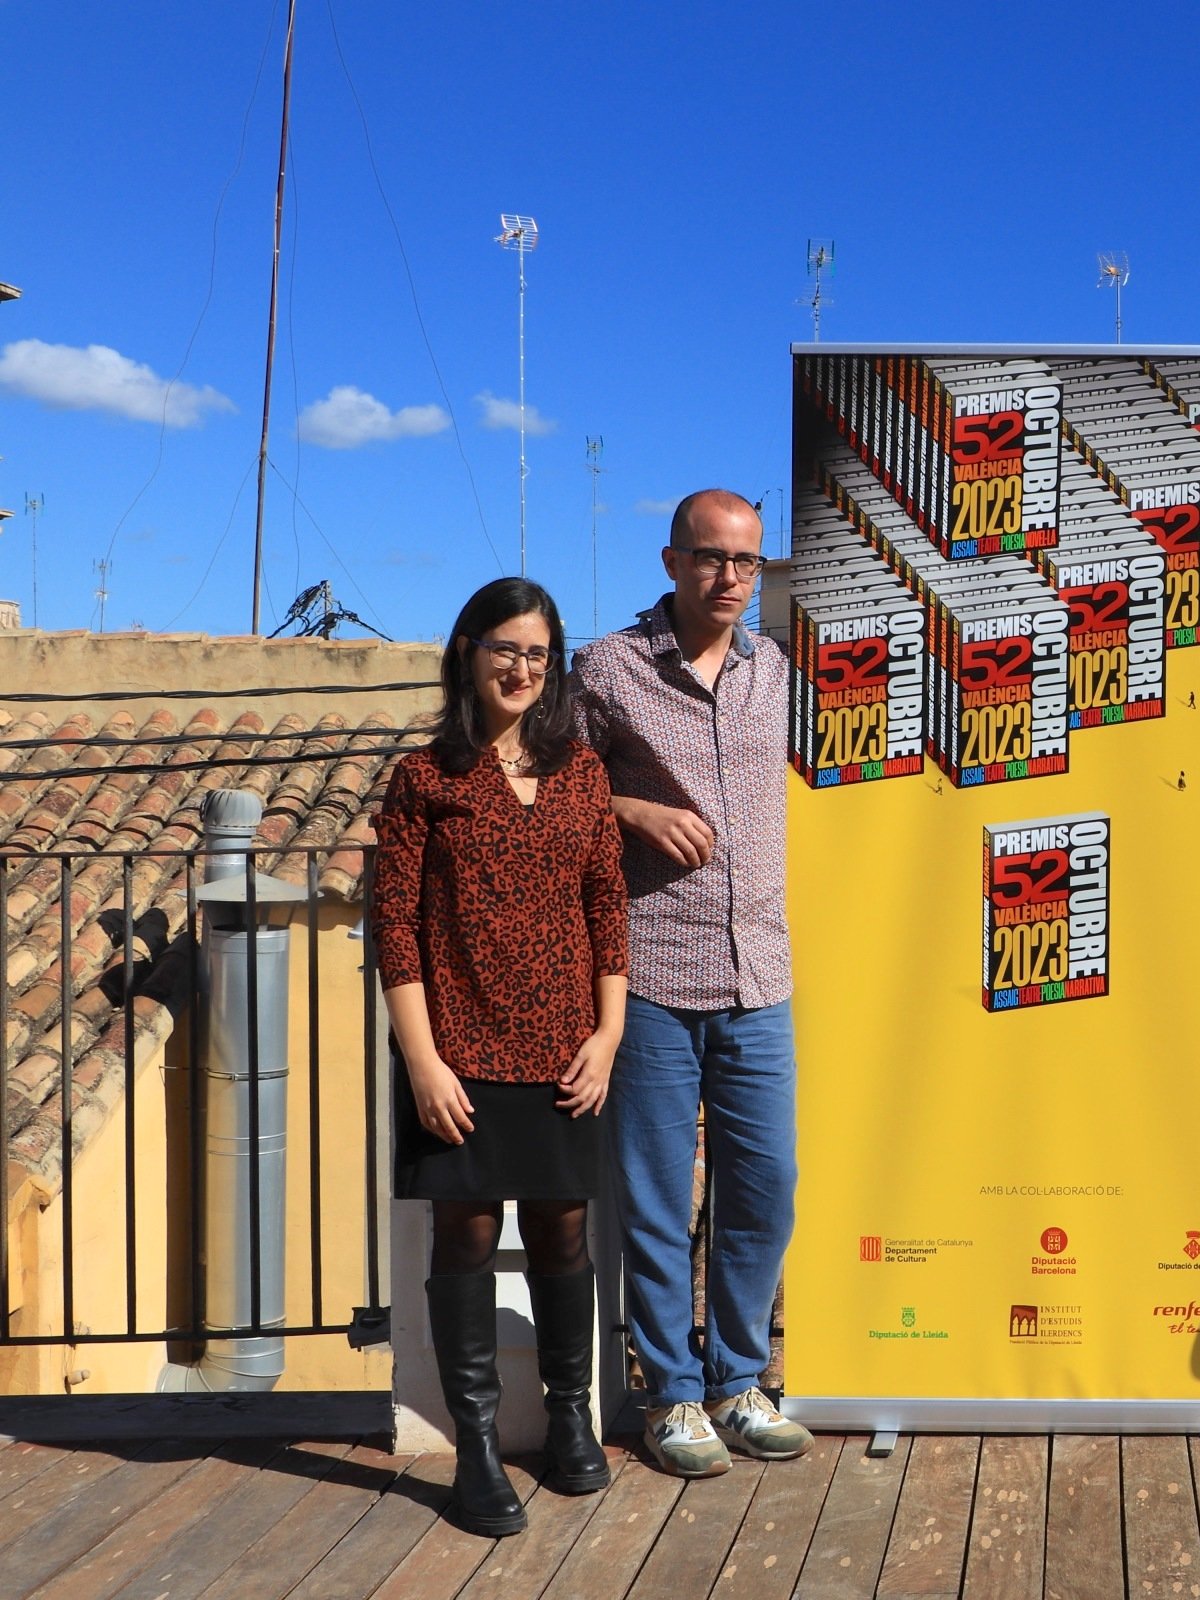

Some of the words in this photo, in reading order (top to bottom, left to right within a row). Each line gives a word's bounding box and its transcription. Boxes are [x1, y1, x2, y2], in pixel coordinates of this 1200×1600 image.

[955, 389, 1024, 417] PREMIS
[952, 411, 1024, 464] 52
[954, 458, 1022, 482] VALÈNCIA
[1022, 386, 1060, 532] OCTUBRE
[952, 475, 1022, 540] 2023
[1131, 482, 1200, 511] PREMIS
[1059, 560, 1128, 588] PREMIS
[1166, 569, 1199, 630] 23
[819, 615, 888, 644] PREMIS
[963, 614, 1032, 643] PREMIS
[1128, 555, 1164, 702] OCTUBRE
[816, 637, 888, 692] 52
[960, 636, 1032, 691] 52
[818, 685, 886, 709] VALÈNCIA
[887, 611, 924, 759] OCTUBRE
[962, 684, 1031, 708] VALÈNCIA
[1031, 610, 1068, 758] OCTUBRE
[817, 702, 887, 769] 2023
[961, 701, 1031, 768] 2023
[994, 825, 1070, 857] PREMIS
[992, 849, 1069, 907] 52
[994, 900, 1068, 926] VALÈNCIA
[1068, 821, 1108, 979] OCTUBRE
[994, 918, 1068, 990] 2023
[980, 1186, 1003, 1196] AMB
[1006, 1186, 1018, 1196] LA
[1106, 1186, 1124, 1196] DE:
[885, 1238, 924, 1246] Generalitat
[926, 1238, 935, 1246] de
[937, 1239, 973, 1247] Catalunya
[885, 1247, 937, 1255] Departament
[1031, 1256, 1076, 1267] Diputació
[1158, 1262, 1192, 1271] Diputació
[869, 1330, 908, 1339] Diputació
[1168, 1322, 1184, 1333] El
